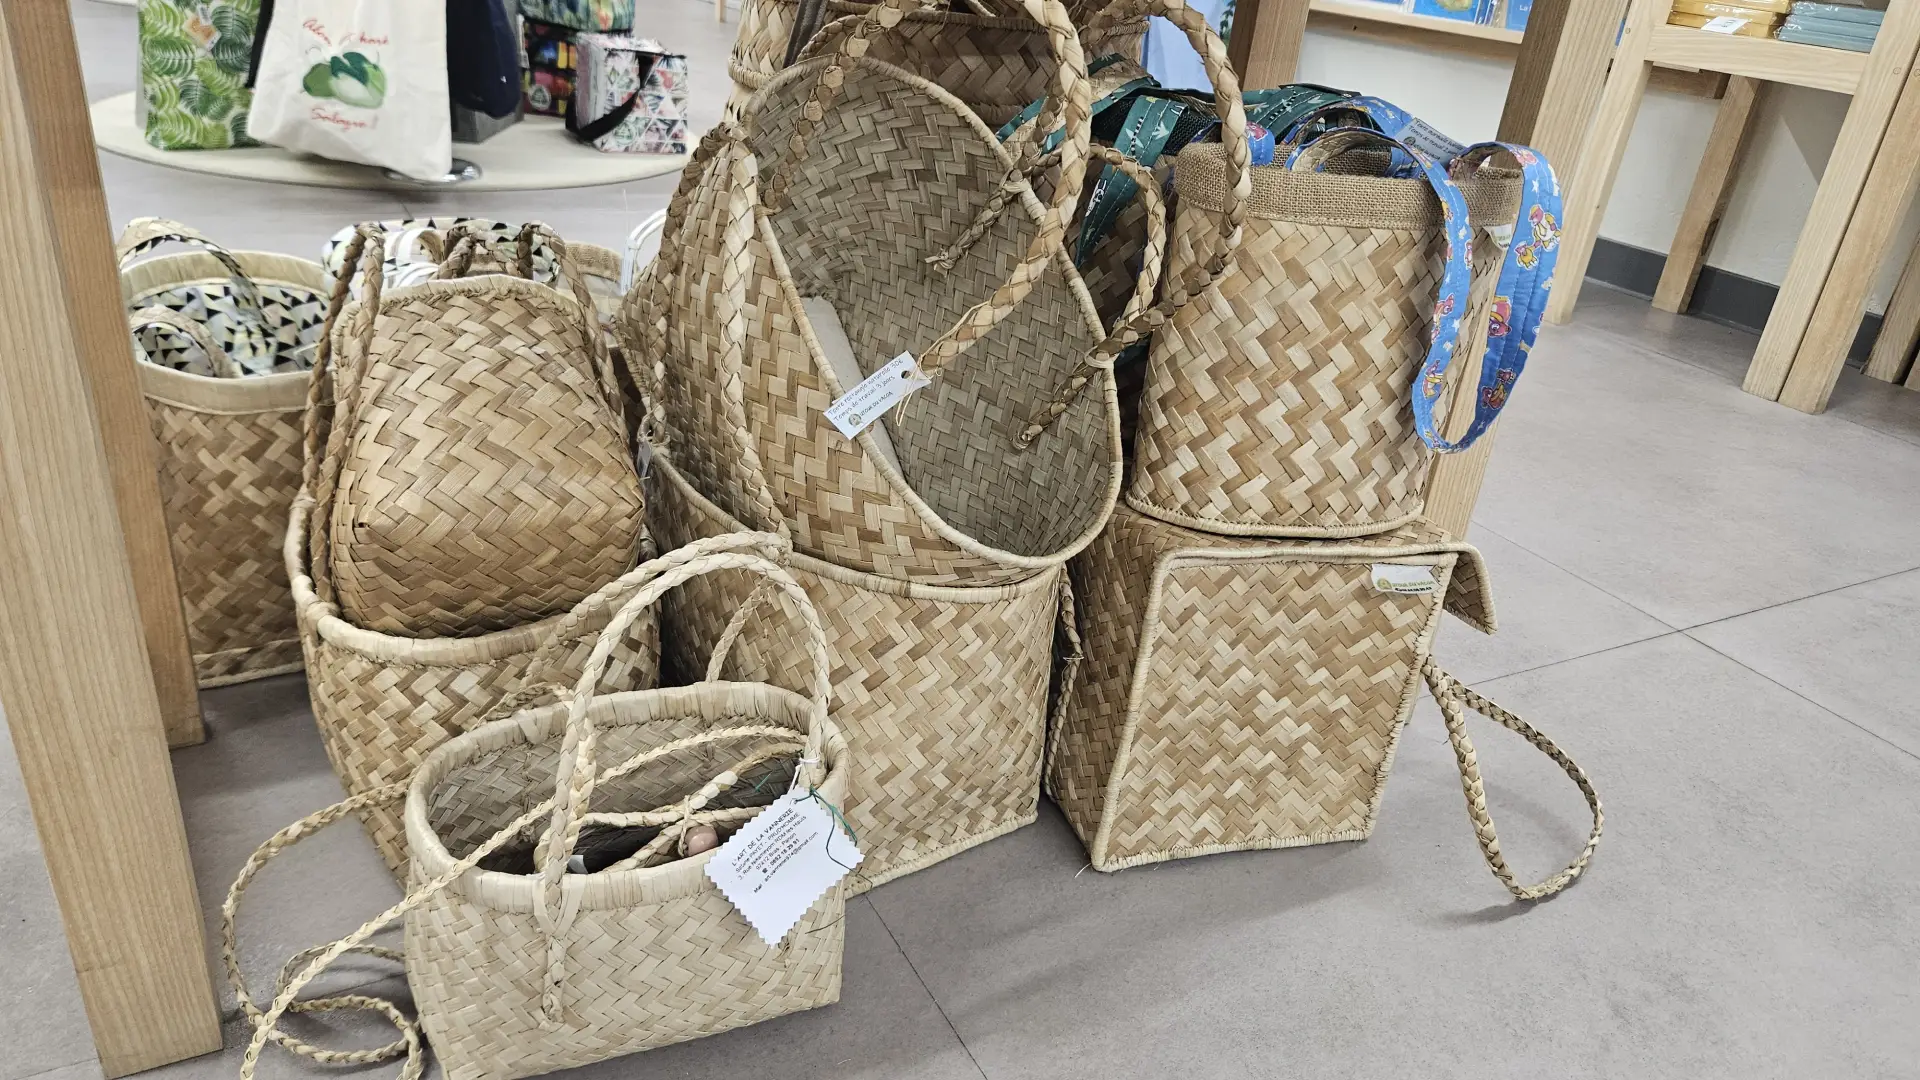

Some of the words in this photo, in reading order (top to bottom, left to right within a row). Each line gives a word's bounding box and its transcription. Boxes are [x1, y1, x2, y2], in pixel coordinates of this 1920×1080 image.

[747, 840, 756, 849] DE
[755, 833, 764, 841] LA
[764, 807, 793, 833] VANNERIE
[749, 842, 763, 857] PAYET
[742, 865, 751, 874] Rue
